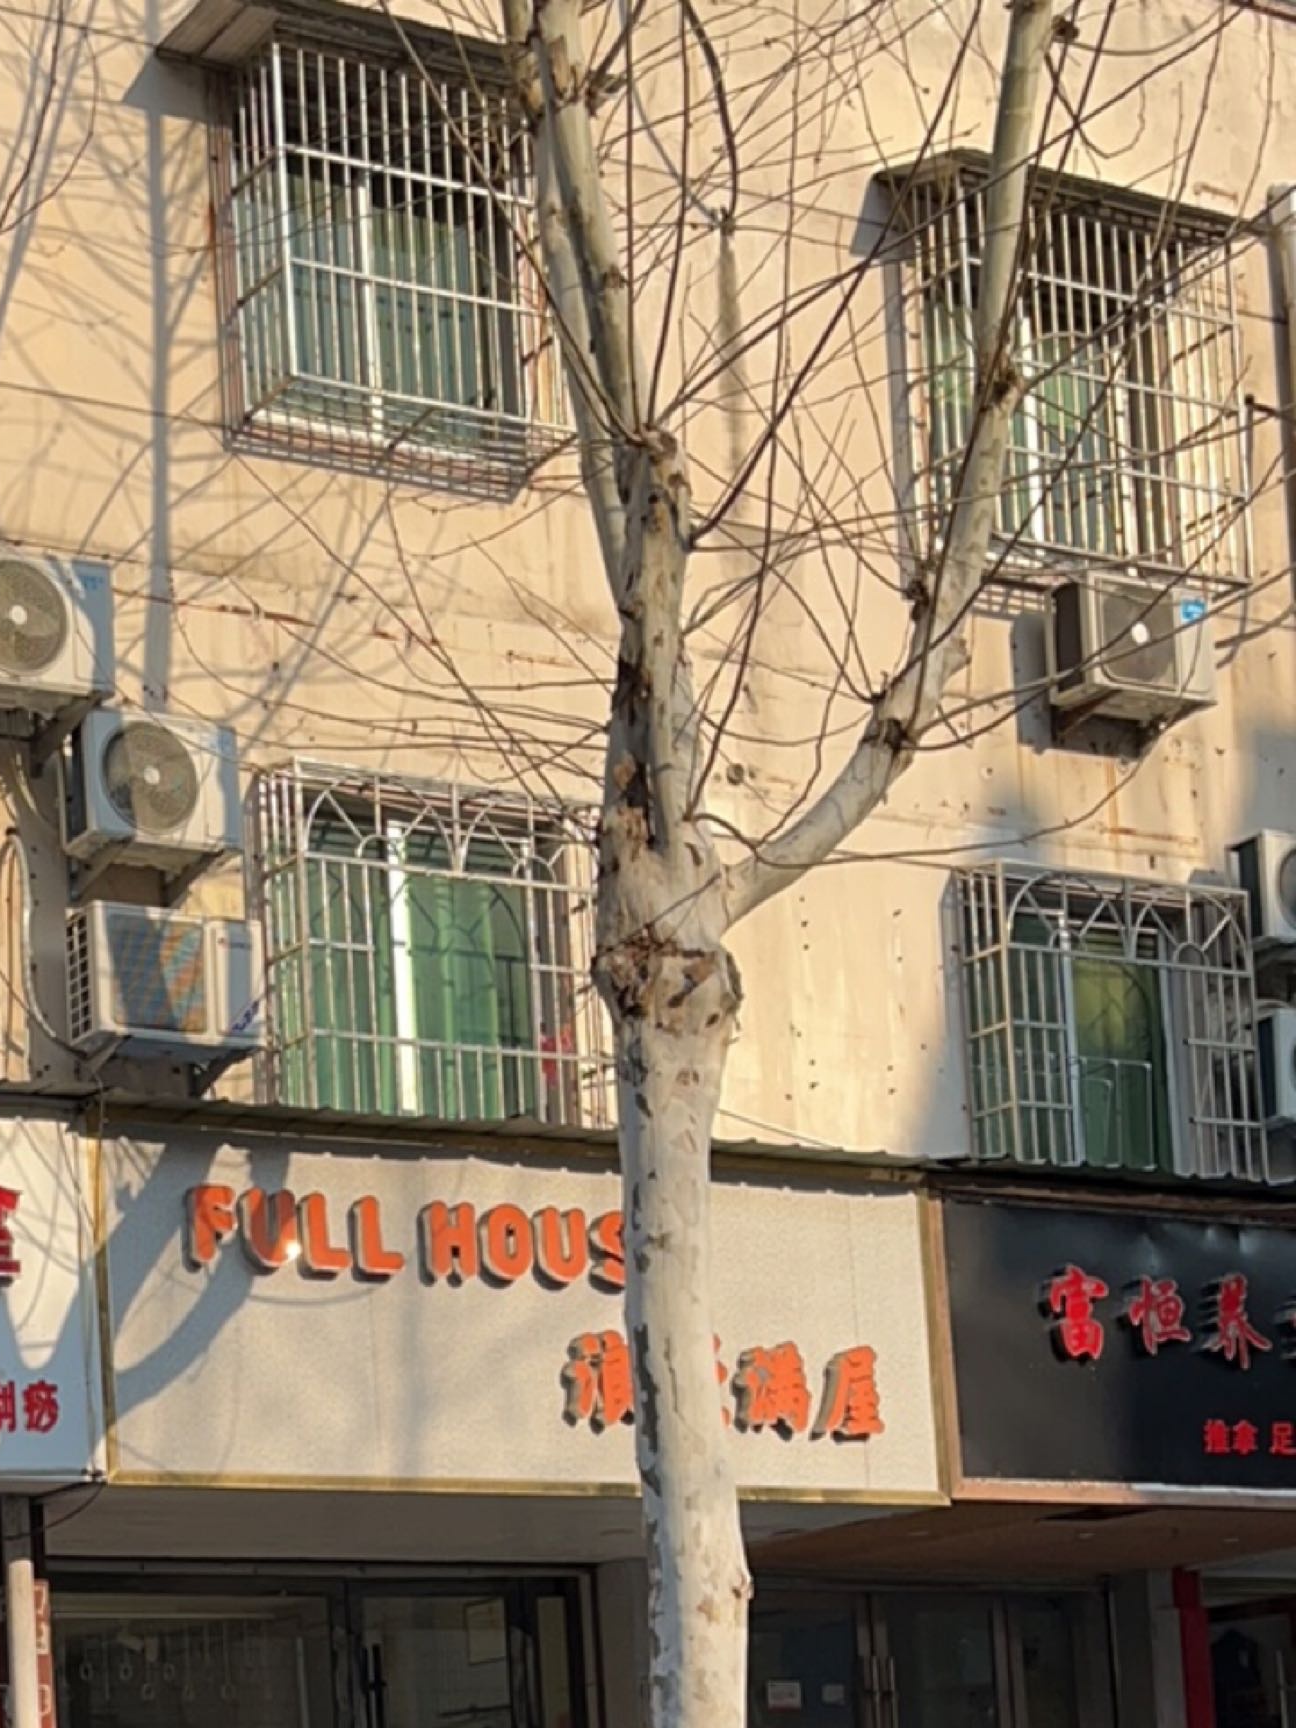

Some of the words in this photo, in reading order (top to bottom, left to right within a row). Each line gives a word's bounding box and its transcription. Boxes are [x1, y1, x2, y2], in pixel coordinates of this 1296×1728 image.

[189, 1184, 405, 1278] FULL
[1042, 1262, 1296, 1370] 富恒养
[564, 1330, 885, 1438] 浪满屋
